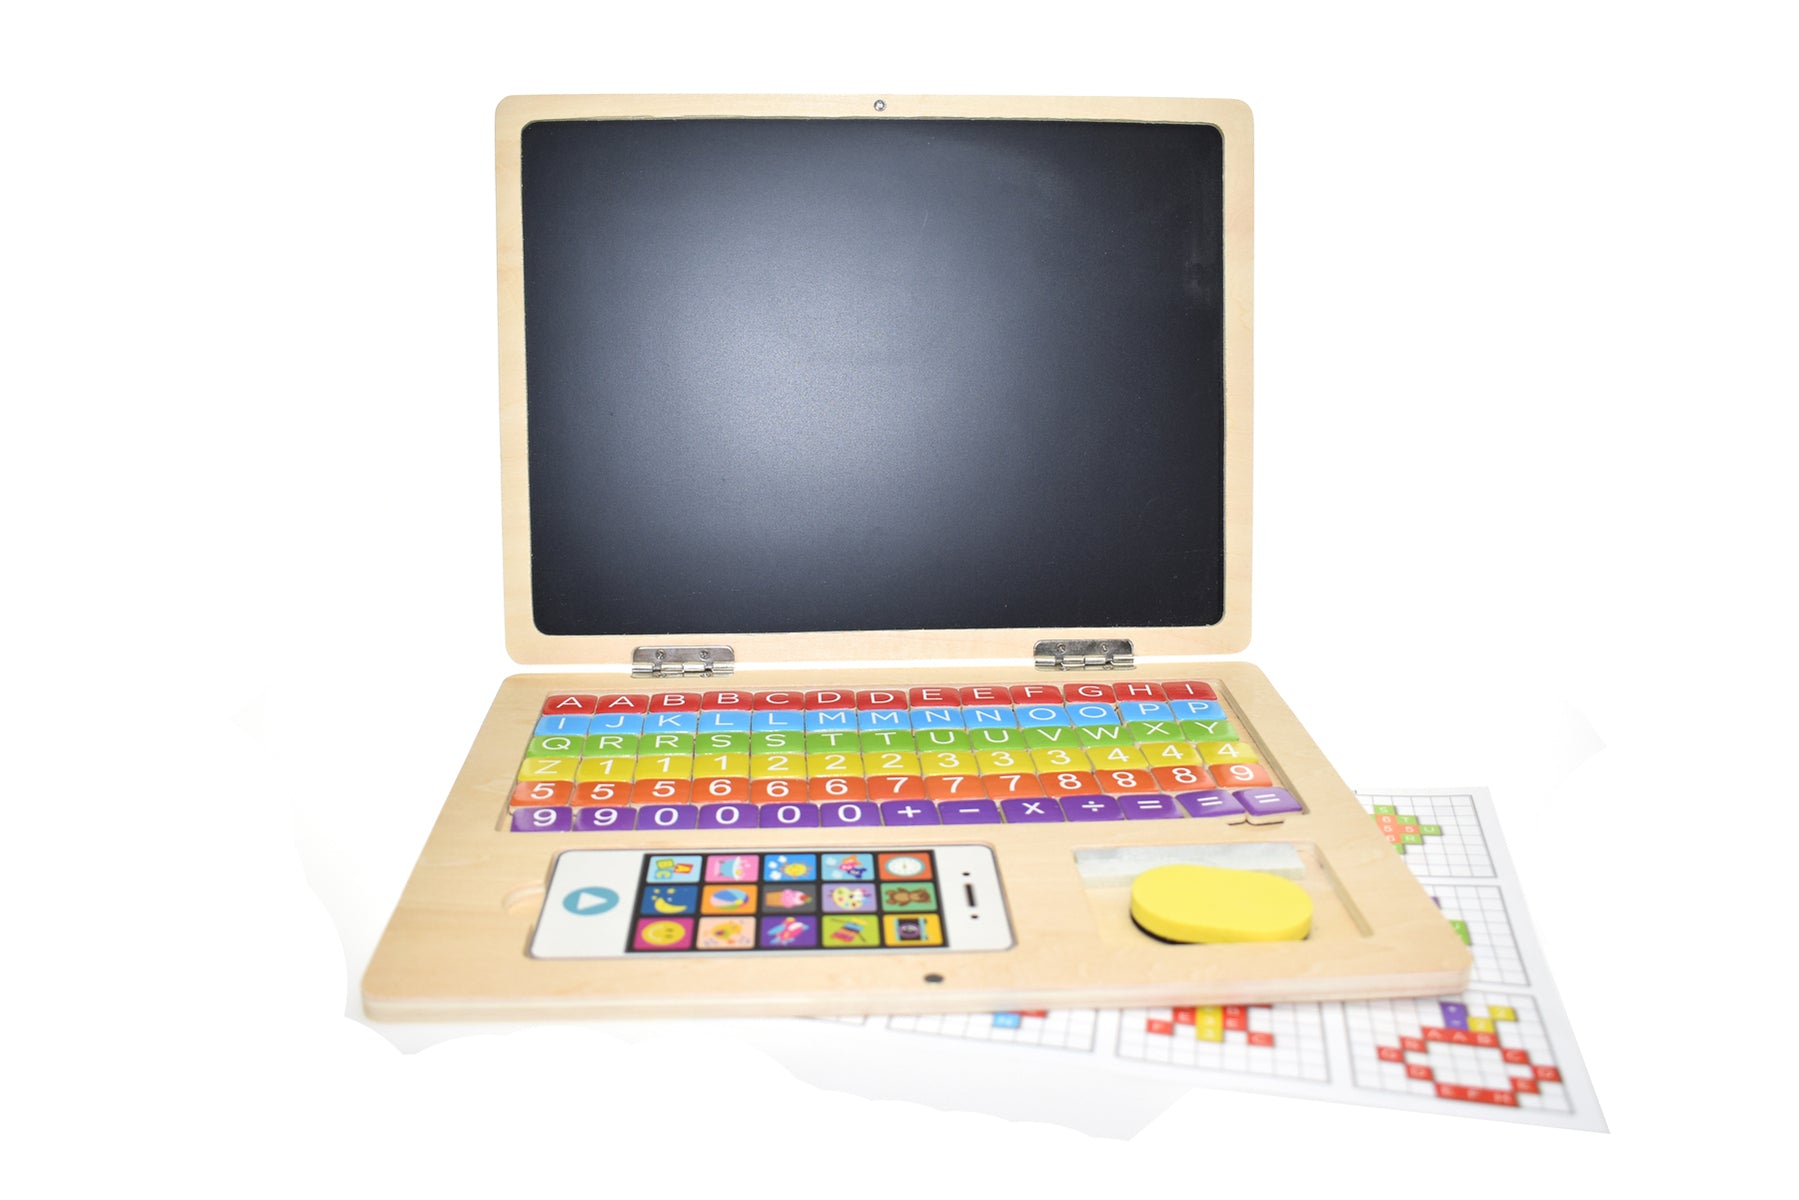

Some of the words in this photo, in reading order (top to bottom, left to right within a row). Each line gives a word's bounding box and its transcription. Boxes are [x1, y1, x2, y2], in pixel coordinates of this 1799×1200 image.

[557, 695, 583, 709] A
[609, 694, 634, 707] A
[663, 694, 686, 706] B
[718, 692, 740, 704] B
[766, 692, 790, 704] C
[817, 691, 841, 703] D
[870, 692, 894, 704] D
[922, 688, 940, 701] E
[973, 687, 994, 699] E
[1025, 686, 1043, 698] F
[1079, 685, 1102, 697] G
[1128, 684, 1152, 696] H
[1186, 683, 1194, 695] I
[558, 717, 566, 729] I
[605, 715, 625, 728] J
[658, 714, 681, 727] K
[714, 713, 733, 725] L
[768, 712, 788, 725] L
[818, 711, 846, 724] M
[871, 711, 899, 724] M
[926, 709, 951, 722] N
[975, 709, 1001, 722] N
[1028, 707, 1057, 721] O
[1079, 706, 1108, 718] O
[1141, 703, 1162, 715] P
[1188, 702, 1209, 714] P
[542, 737, 572, 751] Q
[599, 735, 625, 749] R
[655, 735, 681, 748] R
[711, 734, 732, 748] S
[765, 733, 787, 748] S
[821, 733, 843, 746] T
[878, 732, 897, 745] T
[929, 731, 955, 744] U
[983, 729, 1009, 743] U
[1038, 728, 1062, 742] V
[1083, 726, 1119, 740] W
[1145, 722, 1169, 735] X
[1196, 721, 1219, 734] Y
[536, 760, 561, 774] Z
[600, 759, 614, 775] 1
[657, 756, 671, 772] 1
[715, 755, 728, 771] 1
[767, 755, 789, 771] 2
[826, 754, 847, 770] 2
[881, 753, 903, 769] 2
[937, 752, 960, 768] 3
[991, 751, 1015, 767] 3
[1048, 749, 1071, 765] 3
[1107, 747, 1129, 763] 4
[1161, 744, 1183, 760] 4
[1218, 743, 1240, 758] 4
[530, 782, 556, 800] 5
[590, 783, 615, 800] 5
[652, 780, 676, 798] 5
[709, 778, 732, 796] 6
[766, 780, 790, 798] 6
[825, 778, 848, 795] 6
[886, 776, 909, 794] 7
[942, 776, 964, 794] 7
[1000, 774, 1021, 792] 7
[1057, 773, 1082, 790] 8
[1111, 771, 1137, 788] 8
[1171, 767, 1197, 784] 8
[1230, 764, 1255, 782] 9
[533, 808, 557, 827] 9
[593, 808, 618, 826] 9
[654, 807, 679, 826] 0
[715, 806, 740, 825] 0
[777, 805, 801, 824] 0
[838, 804, 862, 823] 0
